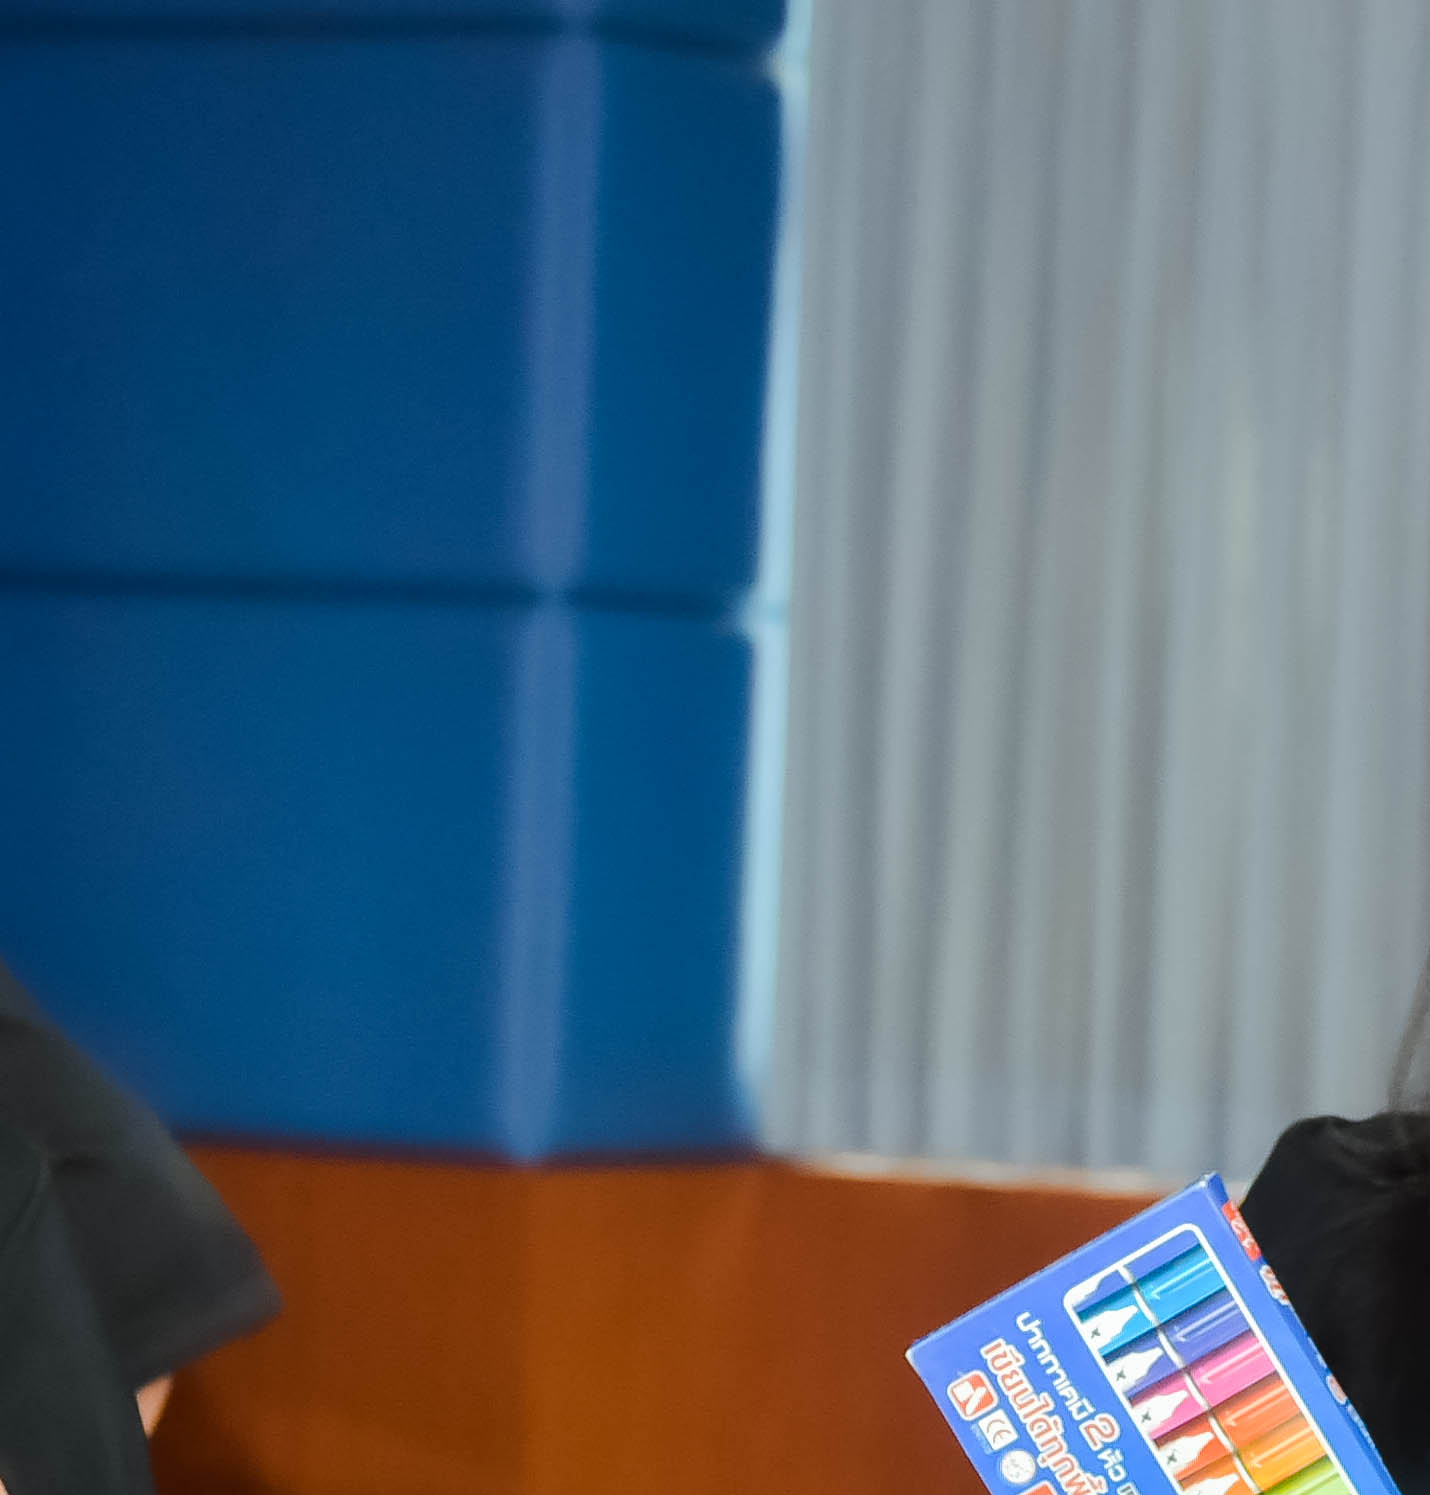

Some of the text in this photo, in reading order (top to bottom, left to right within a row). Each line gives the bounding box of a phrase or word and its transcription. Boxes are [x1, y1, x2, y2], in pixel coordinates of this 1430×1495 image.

[1016, 1311, 1095, 1421] ปากกาเคมี
[1079, 1412, 1121, 1451] 2
[1098, 1448, 1126, 1481] หัว
